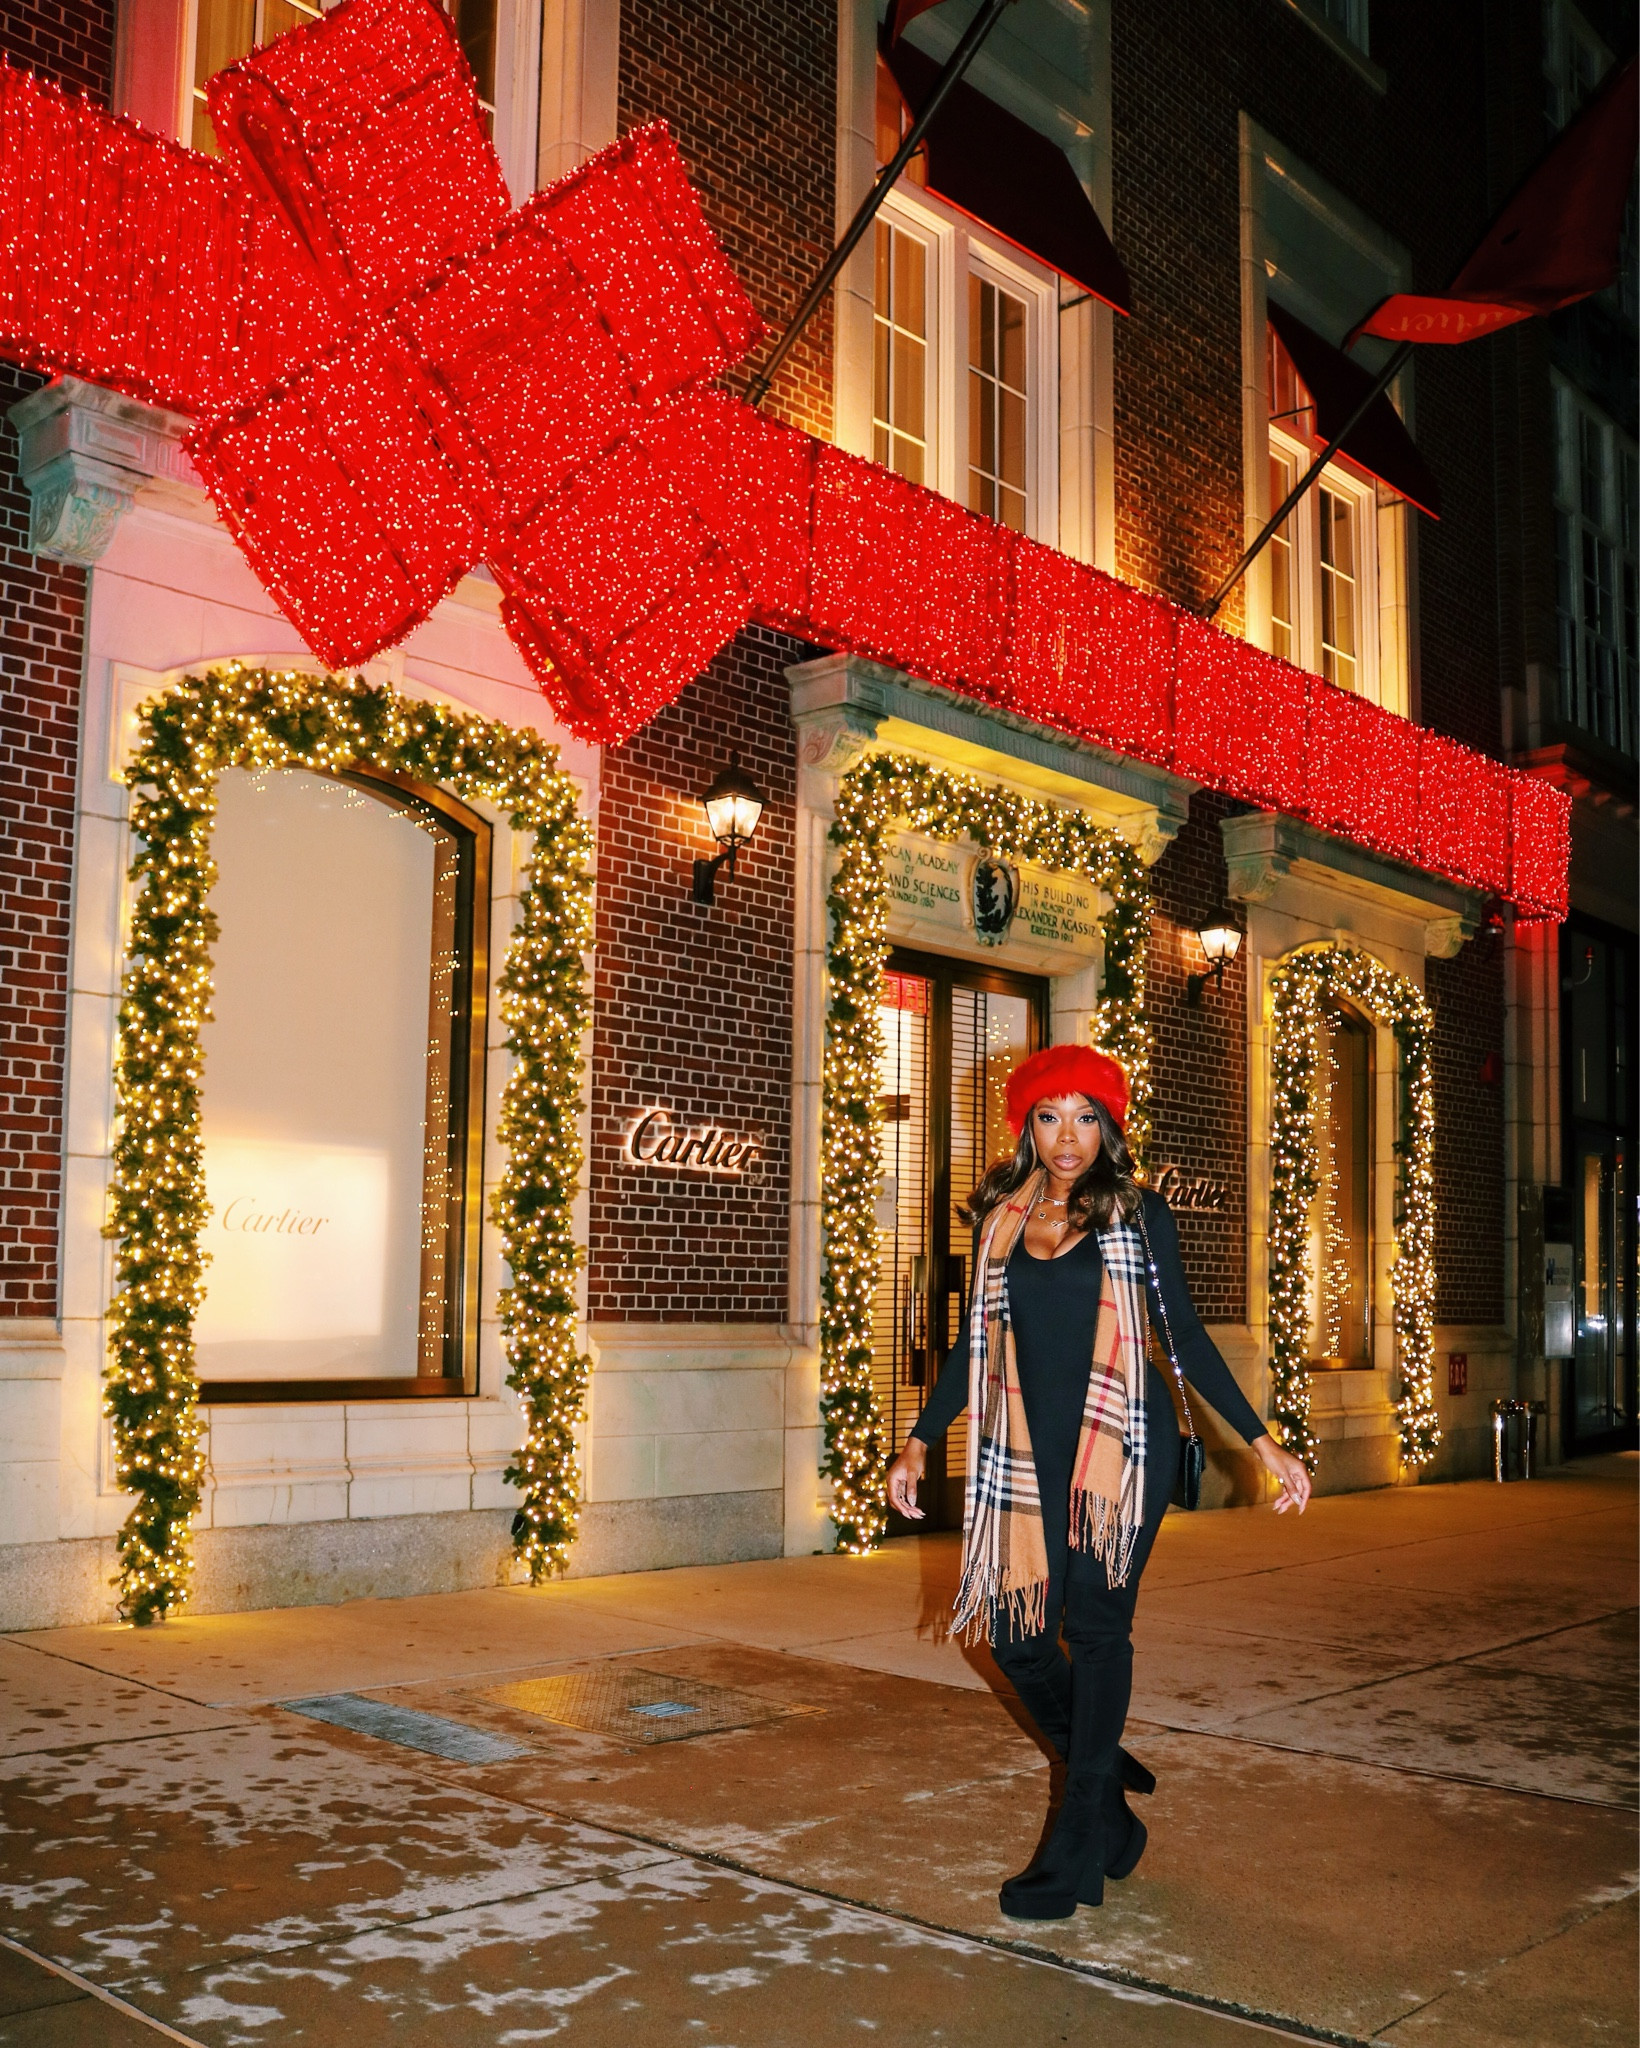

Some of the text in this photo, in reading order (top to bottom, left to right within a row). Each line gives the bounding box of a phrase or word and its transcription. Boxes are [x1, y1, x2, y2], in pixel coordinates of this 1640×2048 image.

[1391, 310, 1521, 334] artier
[904, 864, 914, 875] OF
[915, 852, 960, 875] ACADEMY
[888, 873, 960, 902] AND SCIENCES
[888, 888, 918, 904] OUNDED
[1044, 886, 1089, 909] BUILDING
[1031, 925, 1059, 939] ERECTED
[1061, 918, 1096, 938] AGASSIZ
[631, 1110, 761, 1169] Cartier
[1160, 1167, 1232, 1209] Cartier
[223, 1196, 329, 1234] Cartier
